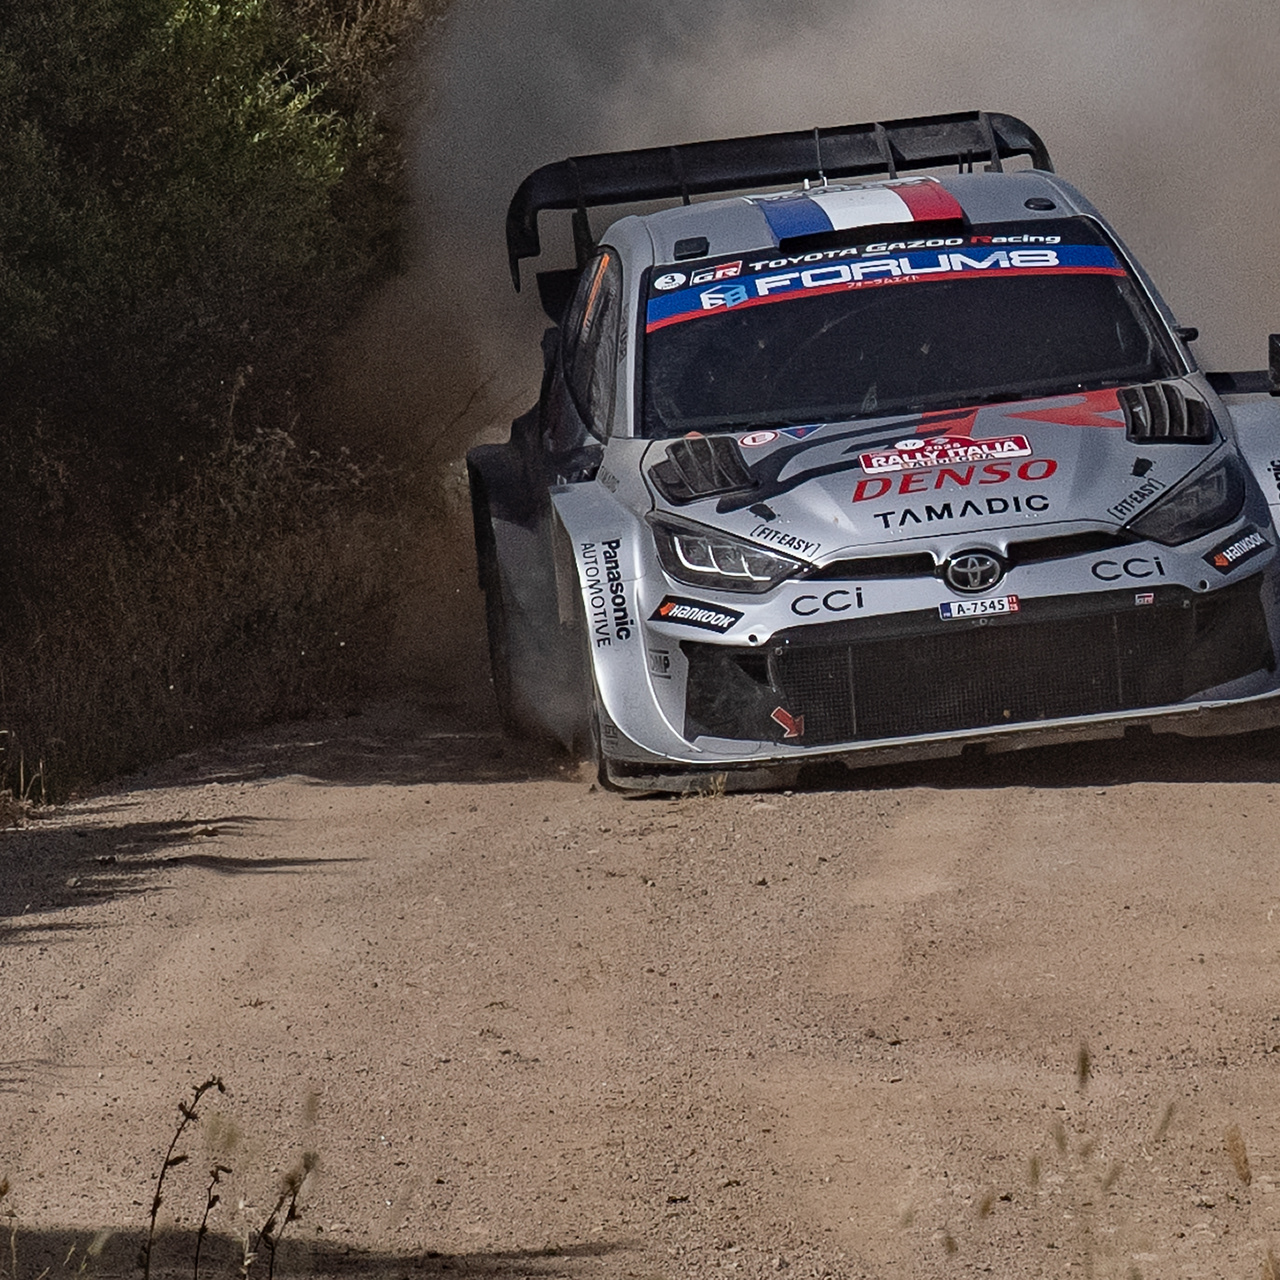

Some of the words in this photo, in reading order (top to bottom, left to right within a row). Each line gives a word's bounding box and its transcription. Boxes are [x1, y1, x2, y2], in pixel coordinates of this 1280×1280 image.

[749, 247, 858, 270] TOYOTA
[863, 237, 964, 257] GAZOO
[970, 234, 1061, 245] Racing
[664, 275, 676, 285] 3
[693, 267, 738, 285] GR
[755, 250, 1060, 297] FORUM8
[871, 450, 940, 468] RALLY
[948, 440, 1020, 459] ITALIA
[904, 441, 917, 449] 17
[852, 459, 1058, 503] DENSO
[873, 494, 1050, 529] TAMADIC
[581, 542, 611, 648] AUTOMOTIVE
[601, 538, 634, 641] Panasonic
[956, 598, 1006, 616] A-7545
